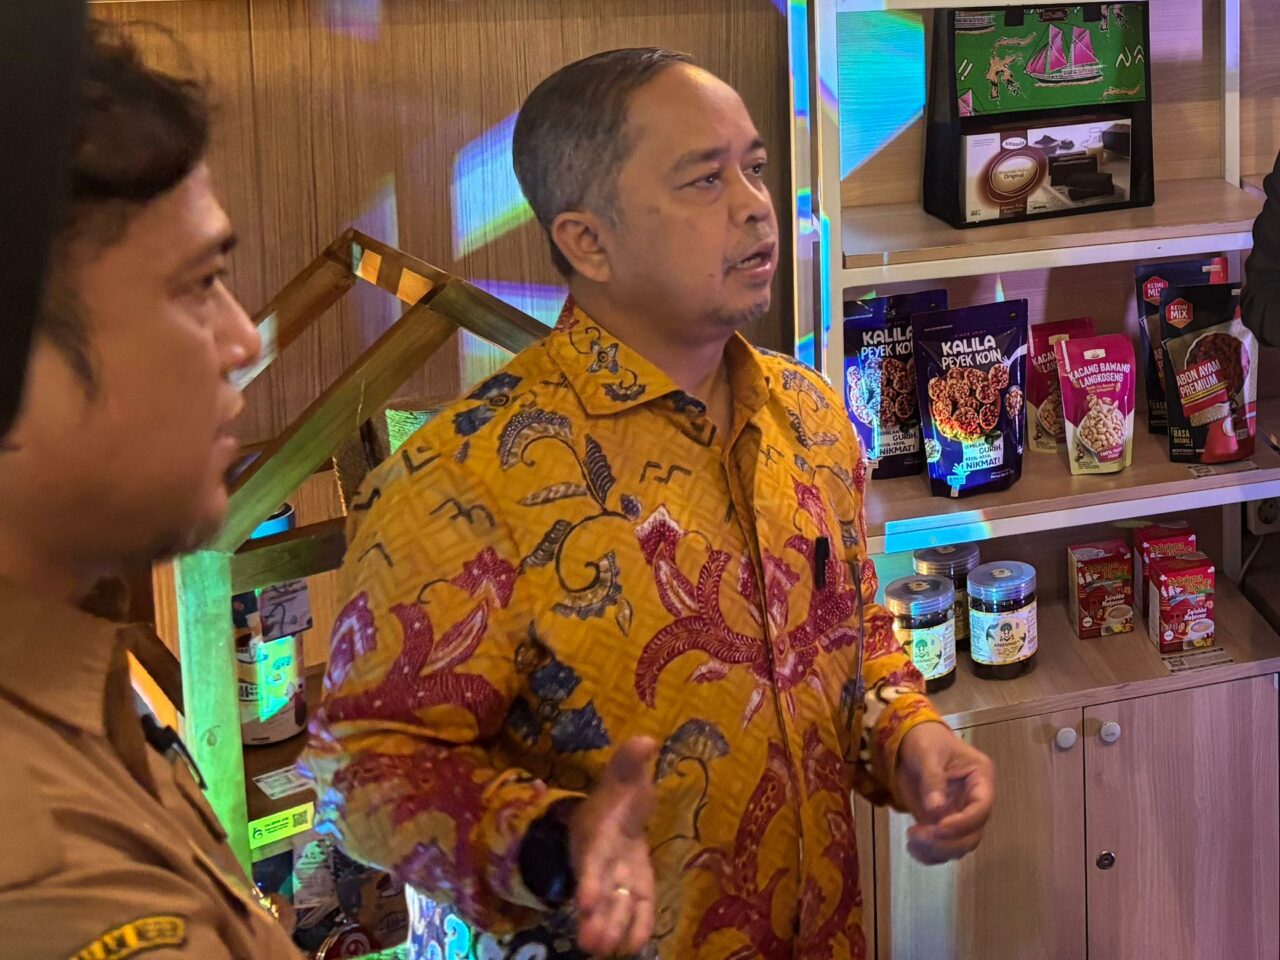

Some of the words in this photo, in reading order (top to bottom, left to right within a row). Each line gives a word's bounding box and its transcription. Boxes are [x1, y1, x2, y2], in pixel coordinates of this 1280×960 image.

[1170, 310, 1188, 320] MIX
[861, 345, 892, 360] PEYEK
[896, 342, 913, 356] KOI
[941, 334, 996, 356] KALILA
[942, 353, 974, 371] PEYEK
[976, 348, 1002, 365] KOIN
[1031, 351, 1057, 367] KACAN
[1068, 364, 1098, 382] KACANG
[1099, 362, 1131, 374] BAWANG
[1079, 372, 1124, 388] LANGKOSENG
[1176, 368, 1199, 387] ABON
[1198, 358, 1222, 376] AYAM
[1180, 373, 1219, 398] PREMIUM
[1173, 429, 1190, 437] RASA
[966, 457, 1000, 469] NIKMAT!
